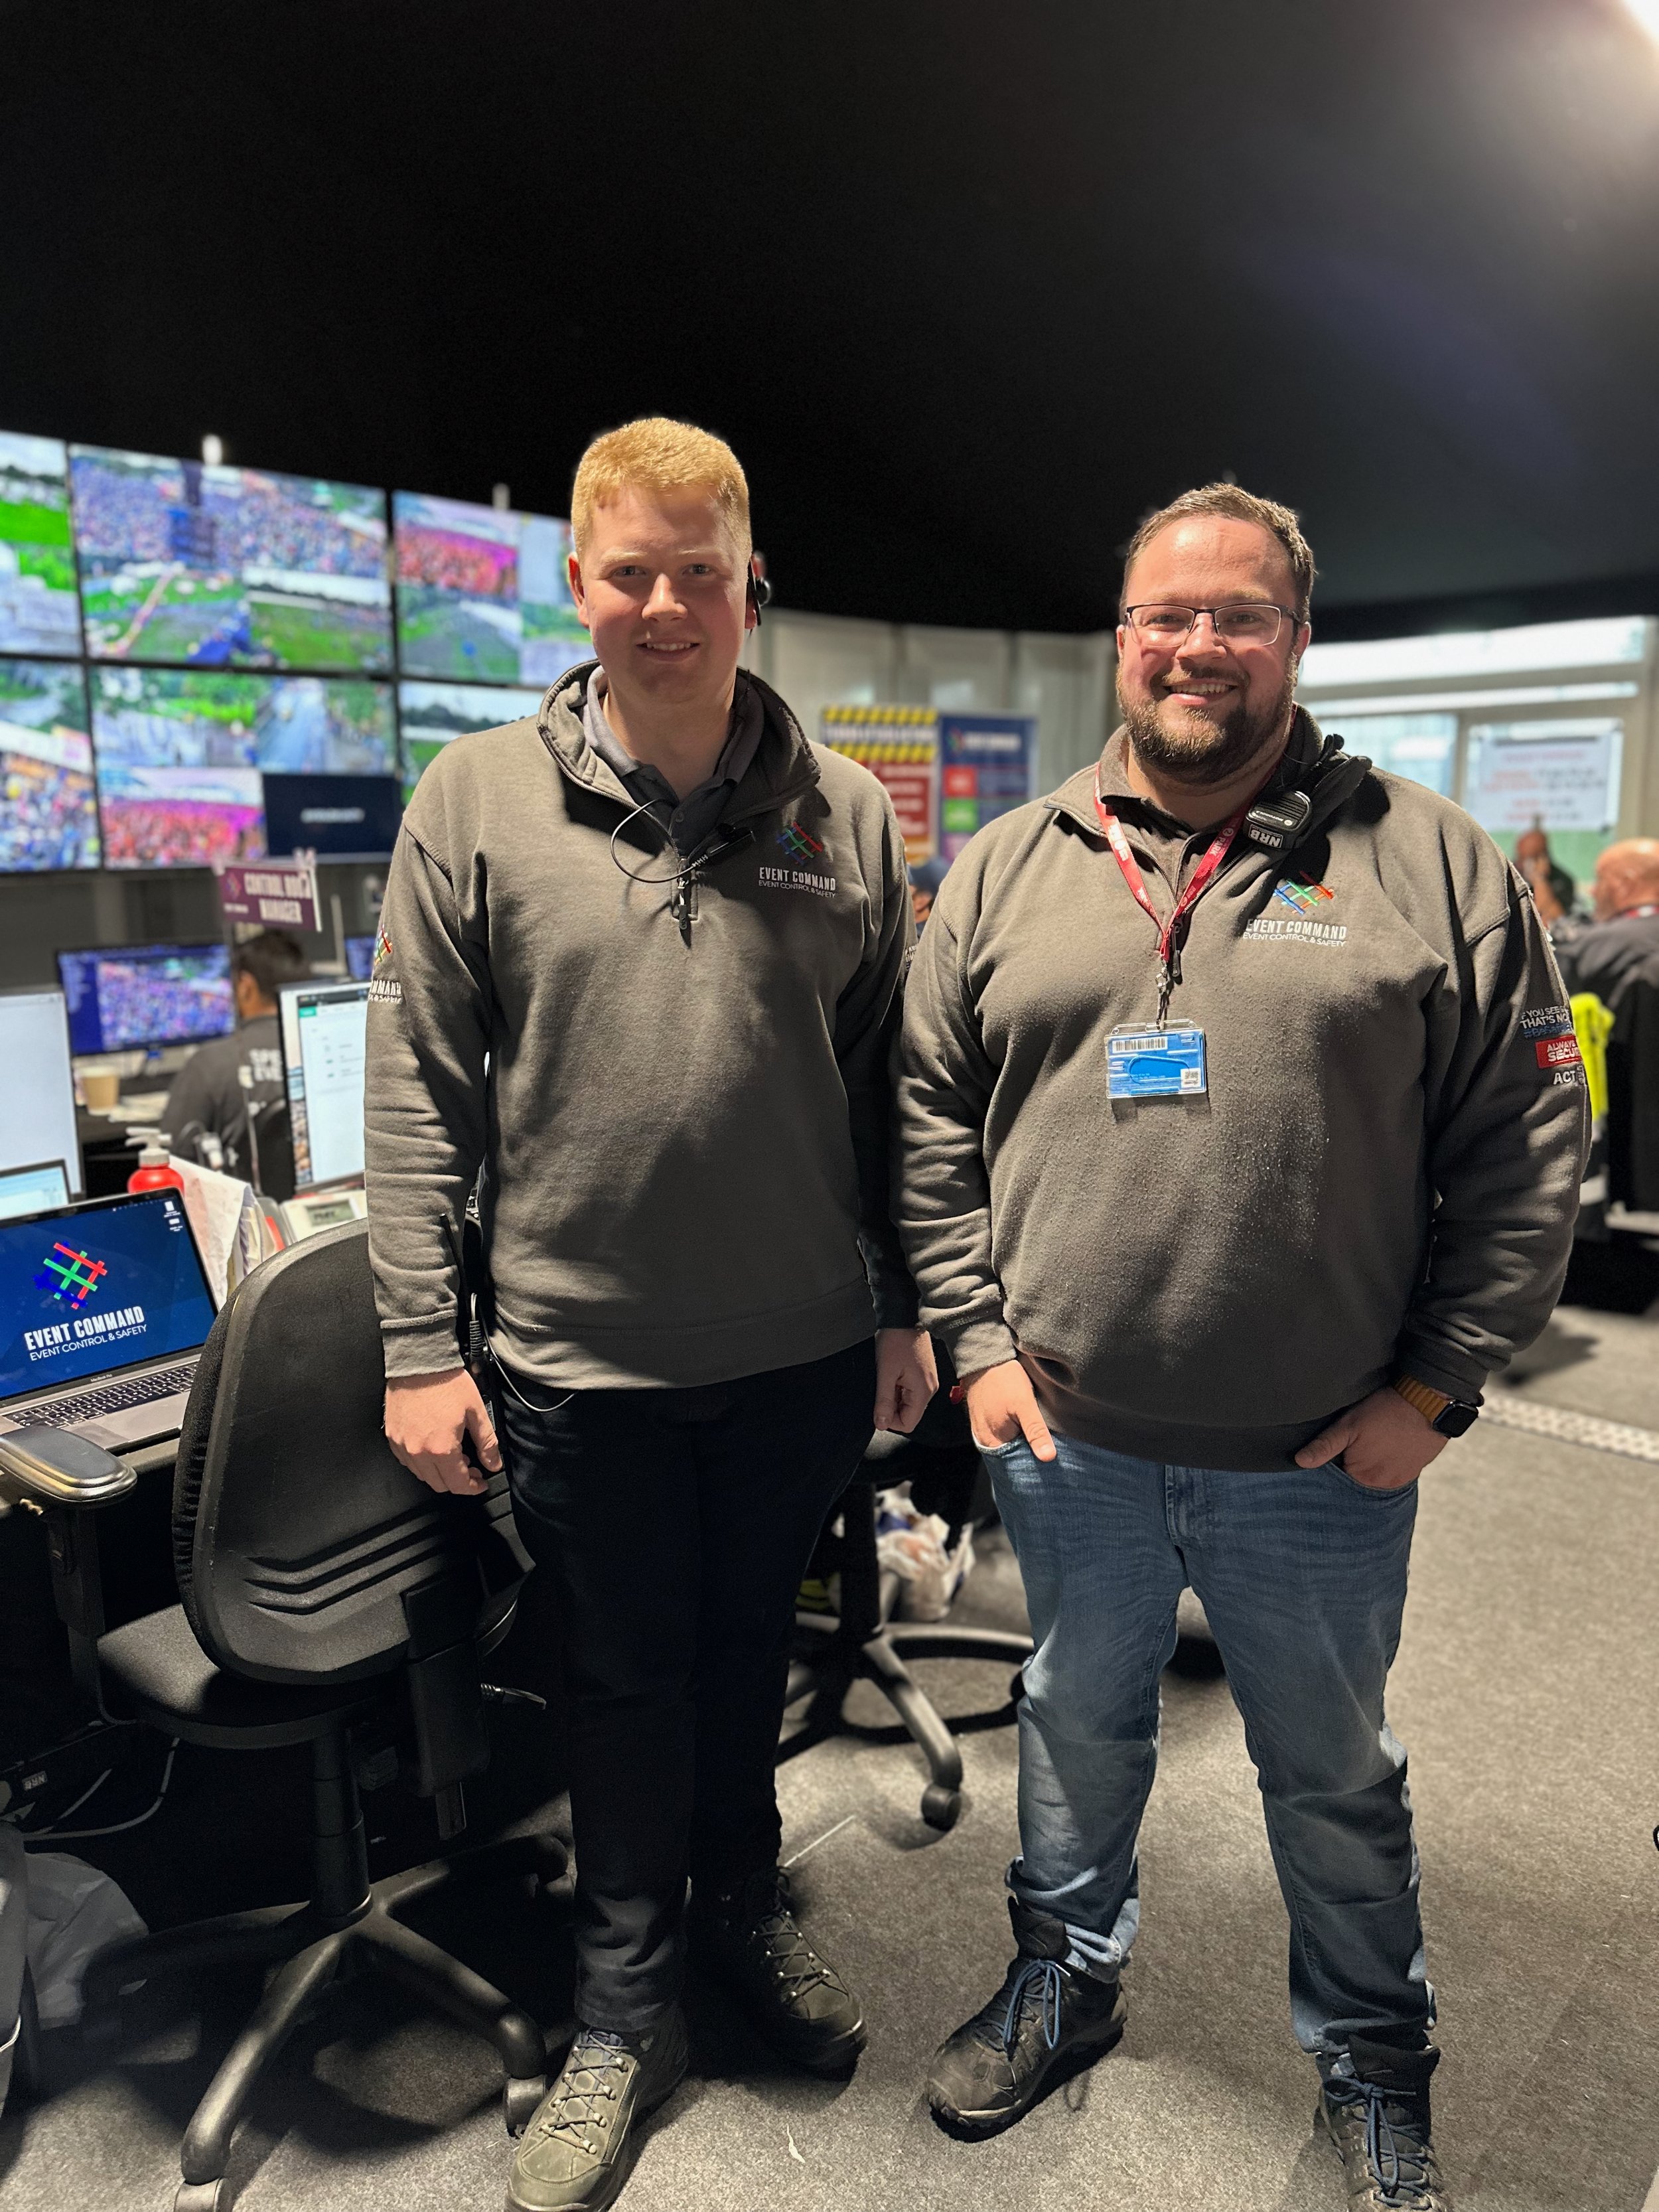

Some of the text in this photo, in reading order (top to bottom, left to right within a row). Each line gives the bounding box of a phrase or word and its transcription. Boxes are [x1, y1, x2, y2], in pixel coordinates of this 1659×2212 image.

[1250, 829, 1281, 847] NRB
[759, 867, 835, 891] EVENT COMMAND
[780, 883, 811, 893] CONTROL
[816, 889, 835, 898] SAFETY
[1246, 919, 1347, 940] EVENT COMMAND
[1242, 932, 1268, 940] EVENT
[1269, 933, 1309, 943] CONTROL
[1317, 938, 1346, 947] SAFETY
[1526, 1008, 1545, 1018] YOU
[1520, 1015, 1555, 1029] THAT'S
[1553, 1070, 1575, 1085] ACT
[24, 1306, 145, 1351] EVENT COMMAND
[30, 1346, 61, 1361] EVENT
[62, 1335, 108, 1353] CONTROL
[116, 1324, 147, 1339] SAFETY
